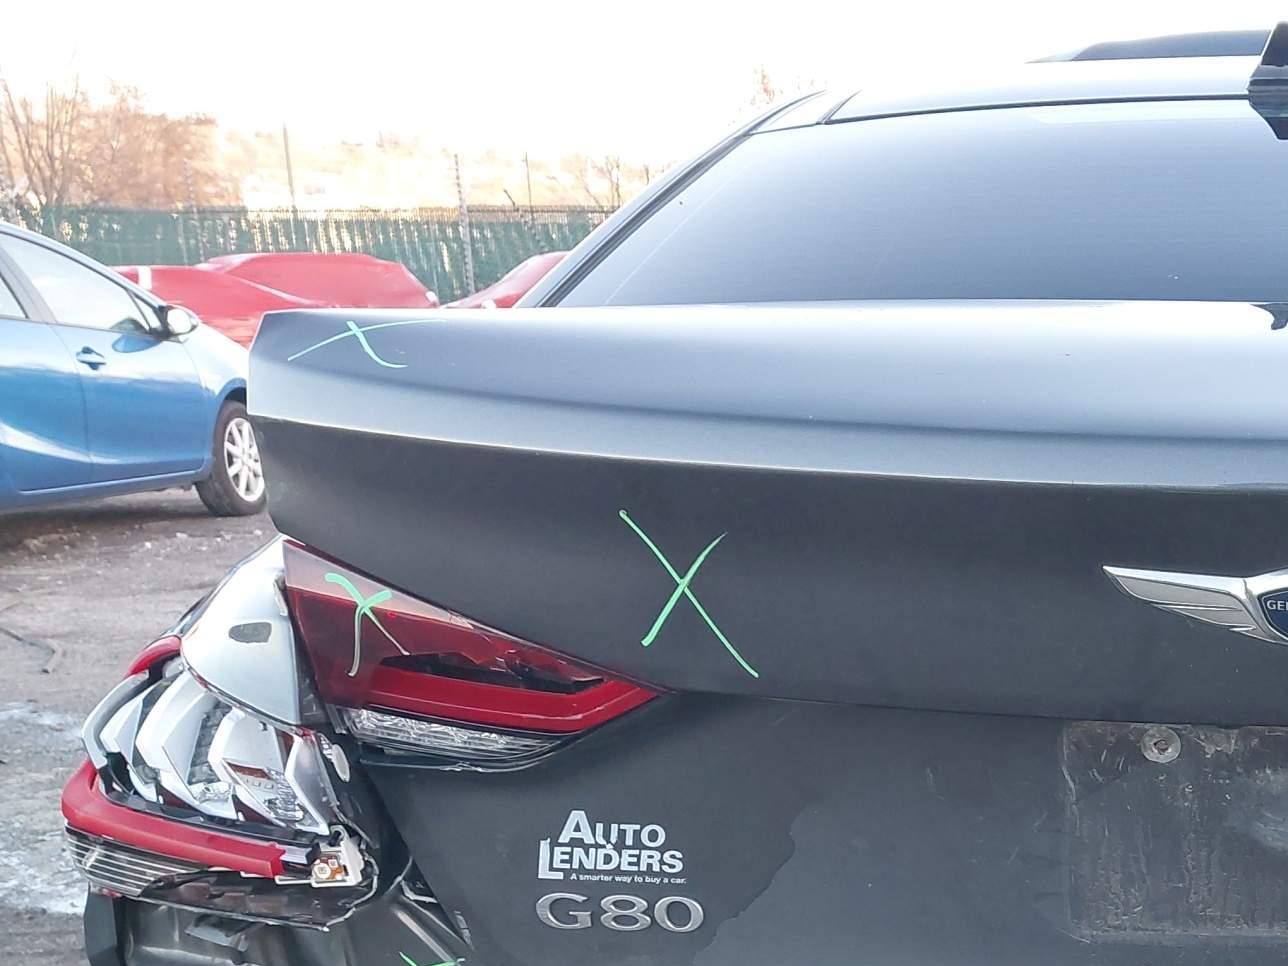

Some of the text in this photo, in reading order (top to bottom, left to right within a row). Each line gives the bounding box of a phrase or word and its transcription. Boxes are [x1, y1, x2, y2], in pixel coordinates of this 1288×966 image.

[570, 873, 578, 881] A
[579, 873, 613, 882] smarter
[615, 875, 632, 884] way
[634, 875, 643, 883] to
[645, 876, 661, 885] buy
[535, 892, 705, 933] G80
